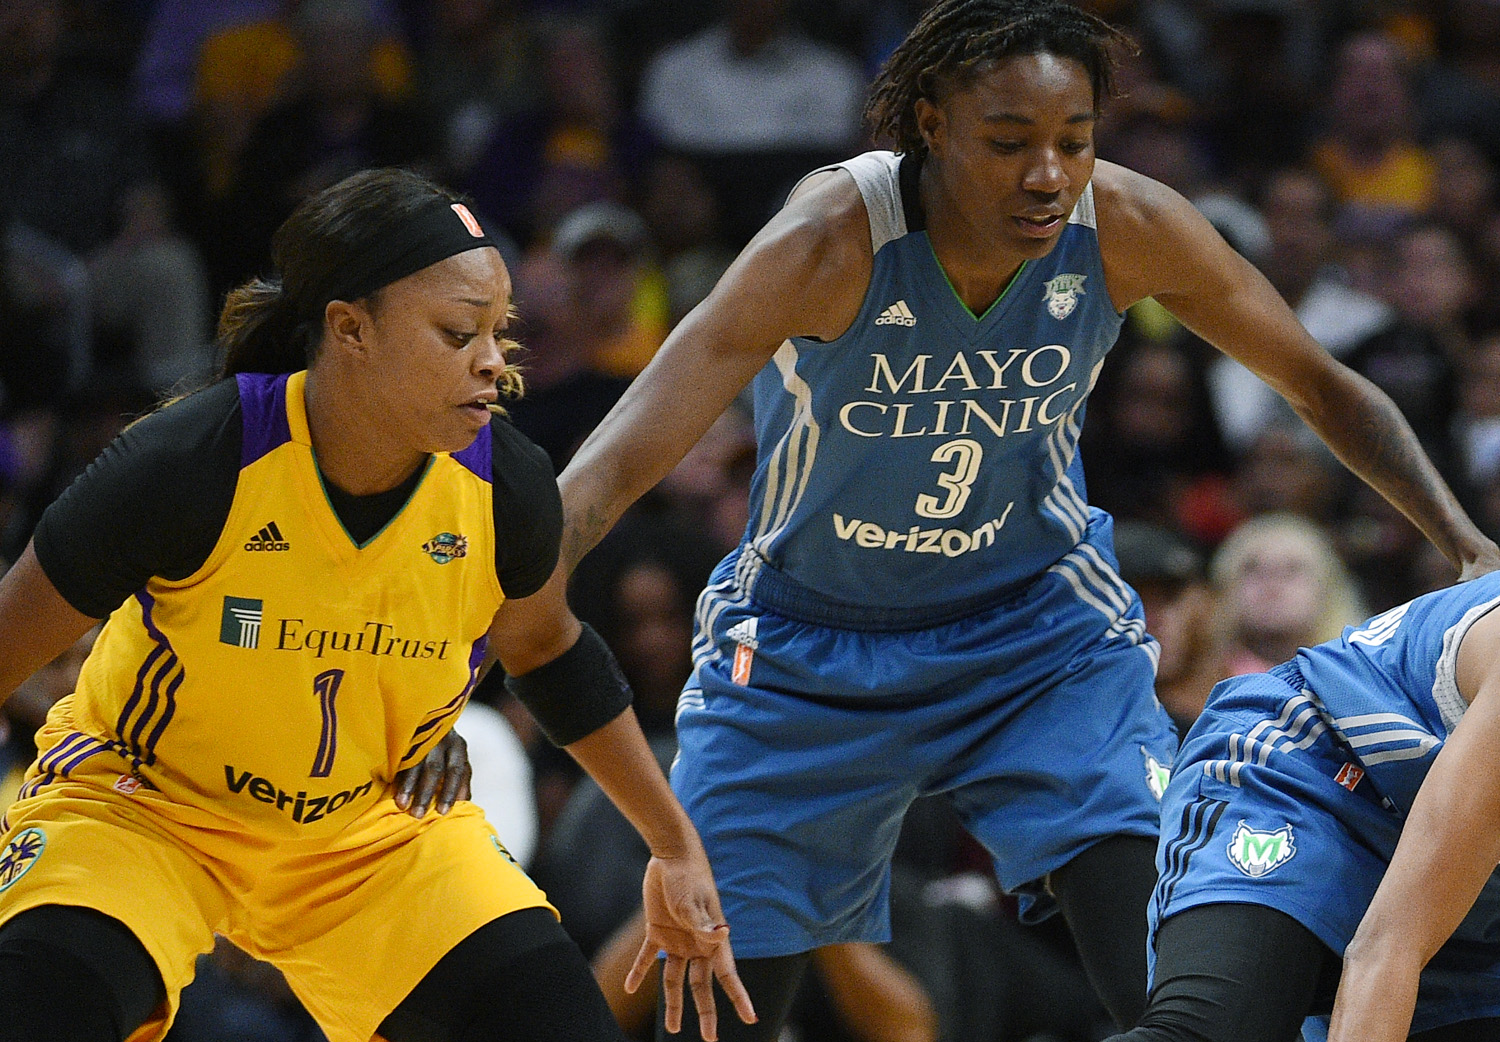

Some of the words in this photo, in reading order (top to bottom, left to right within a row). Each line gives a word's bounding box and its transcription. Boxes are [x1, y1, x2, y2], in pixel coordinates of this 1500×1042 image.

[864, 344, 1071, 395] MAYO
[839, 383, 1076, 438] CLINIC
[914, 438, 984, 519] 3
[244, 541, 290, 552] adidas
[833, 512, 996, 558] verizon
[275, 618, 452, 661] EquiTrust
[309, 668, 345, 778] 1
[223, 764, 373, 825] verizon
